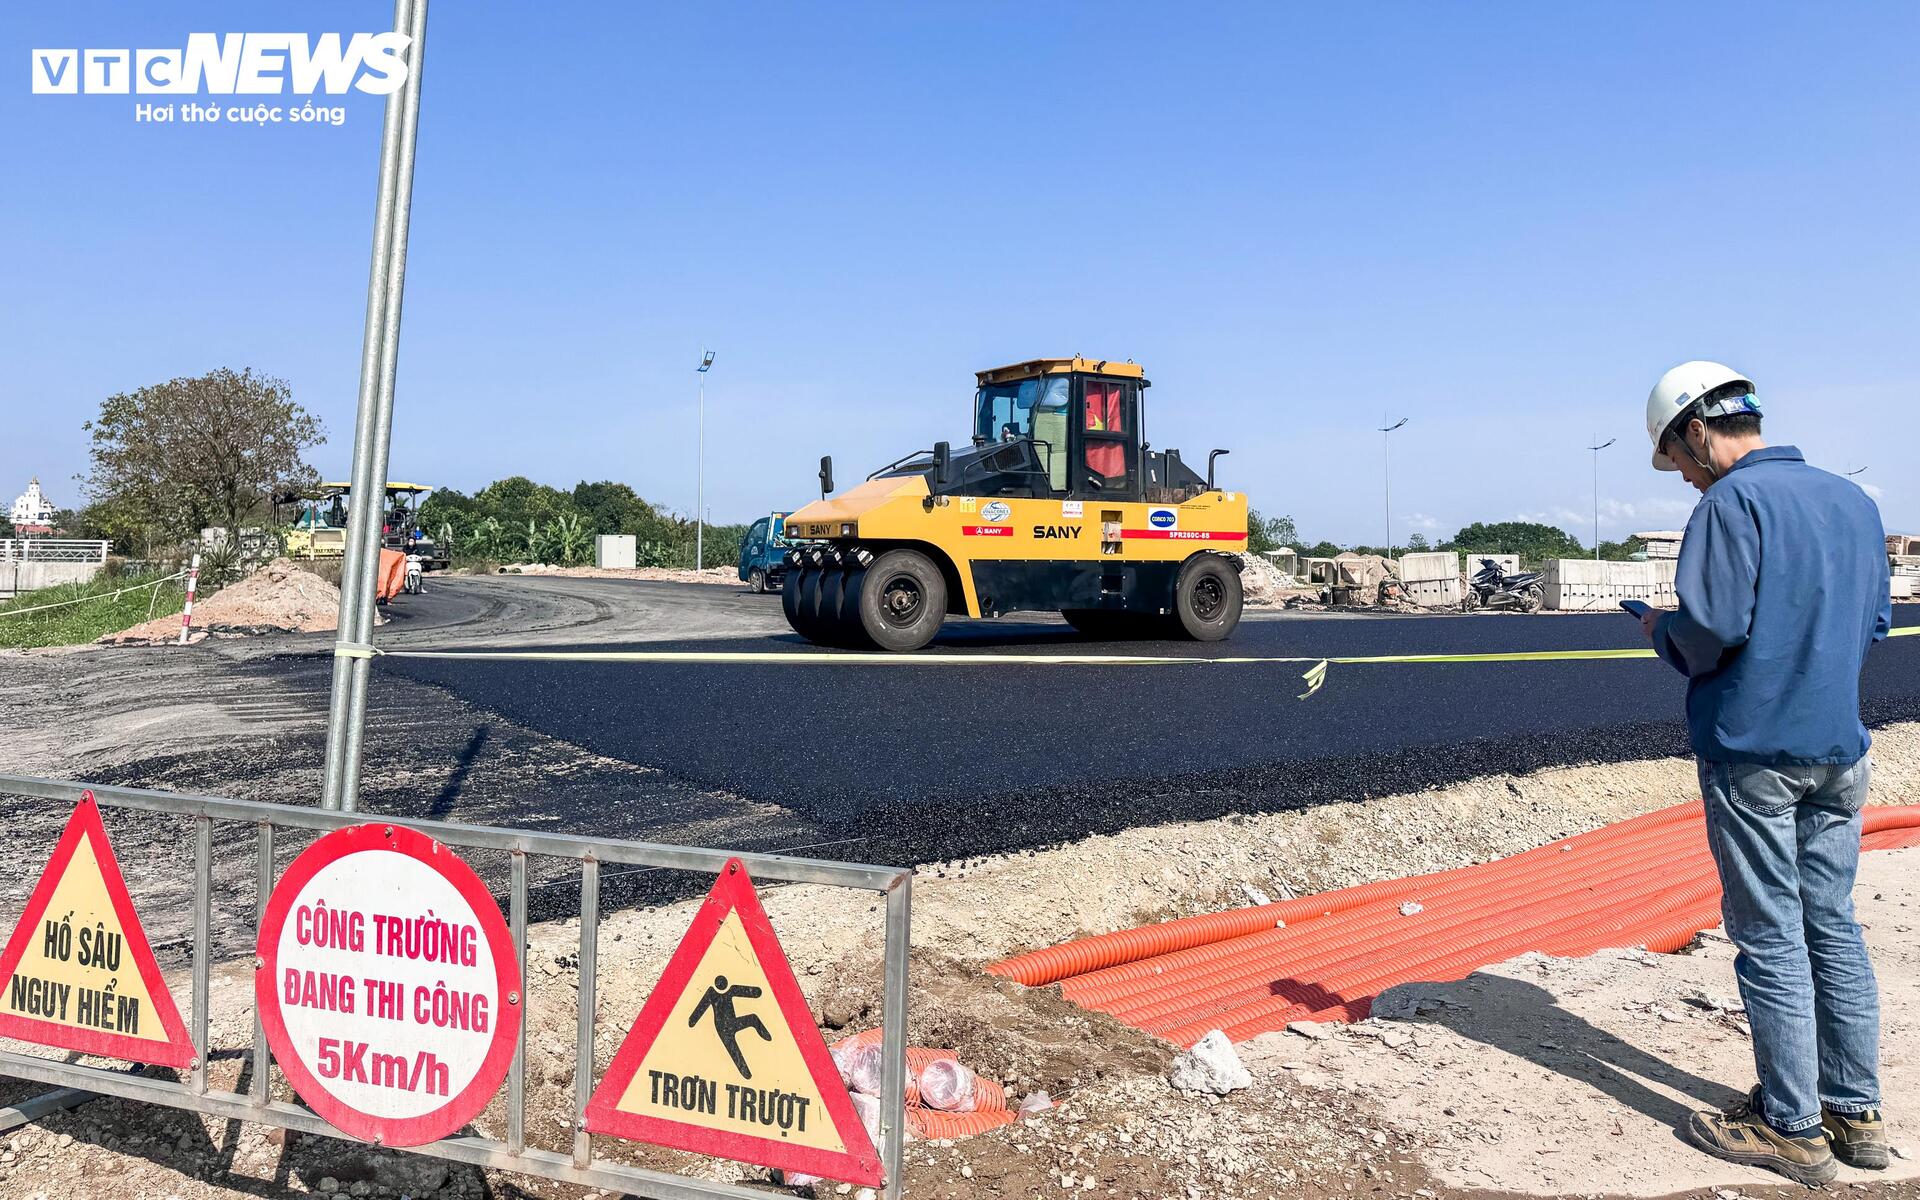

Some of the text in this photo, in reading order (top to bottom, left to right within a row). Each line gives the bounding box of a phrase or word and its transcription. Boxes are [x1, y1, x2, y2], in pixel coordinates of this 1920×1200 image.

[810, 525, 831, 535] SANY
[1033, 525, 1082, 539] SANY
[44, 911, 121, 971] HỐ SÂU
[297, 899, 477, 967] CÔNG TRƯỜNG
[11, 973, 140, 1034] NGUY HIỂM
[284, 967, 489, 1034] ĐANG THI CÔNG
[317, 1037, 449, 1097] 5Km/h
[648, 1069, 811, 1138] TRƠN TRƯỢT
